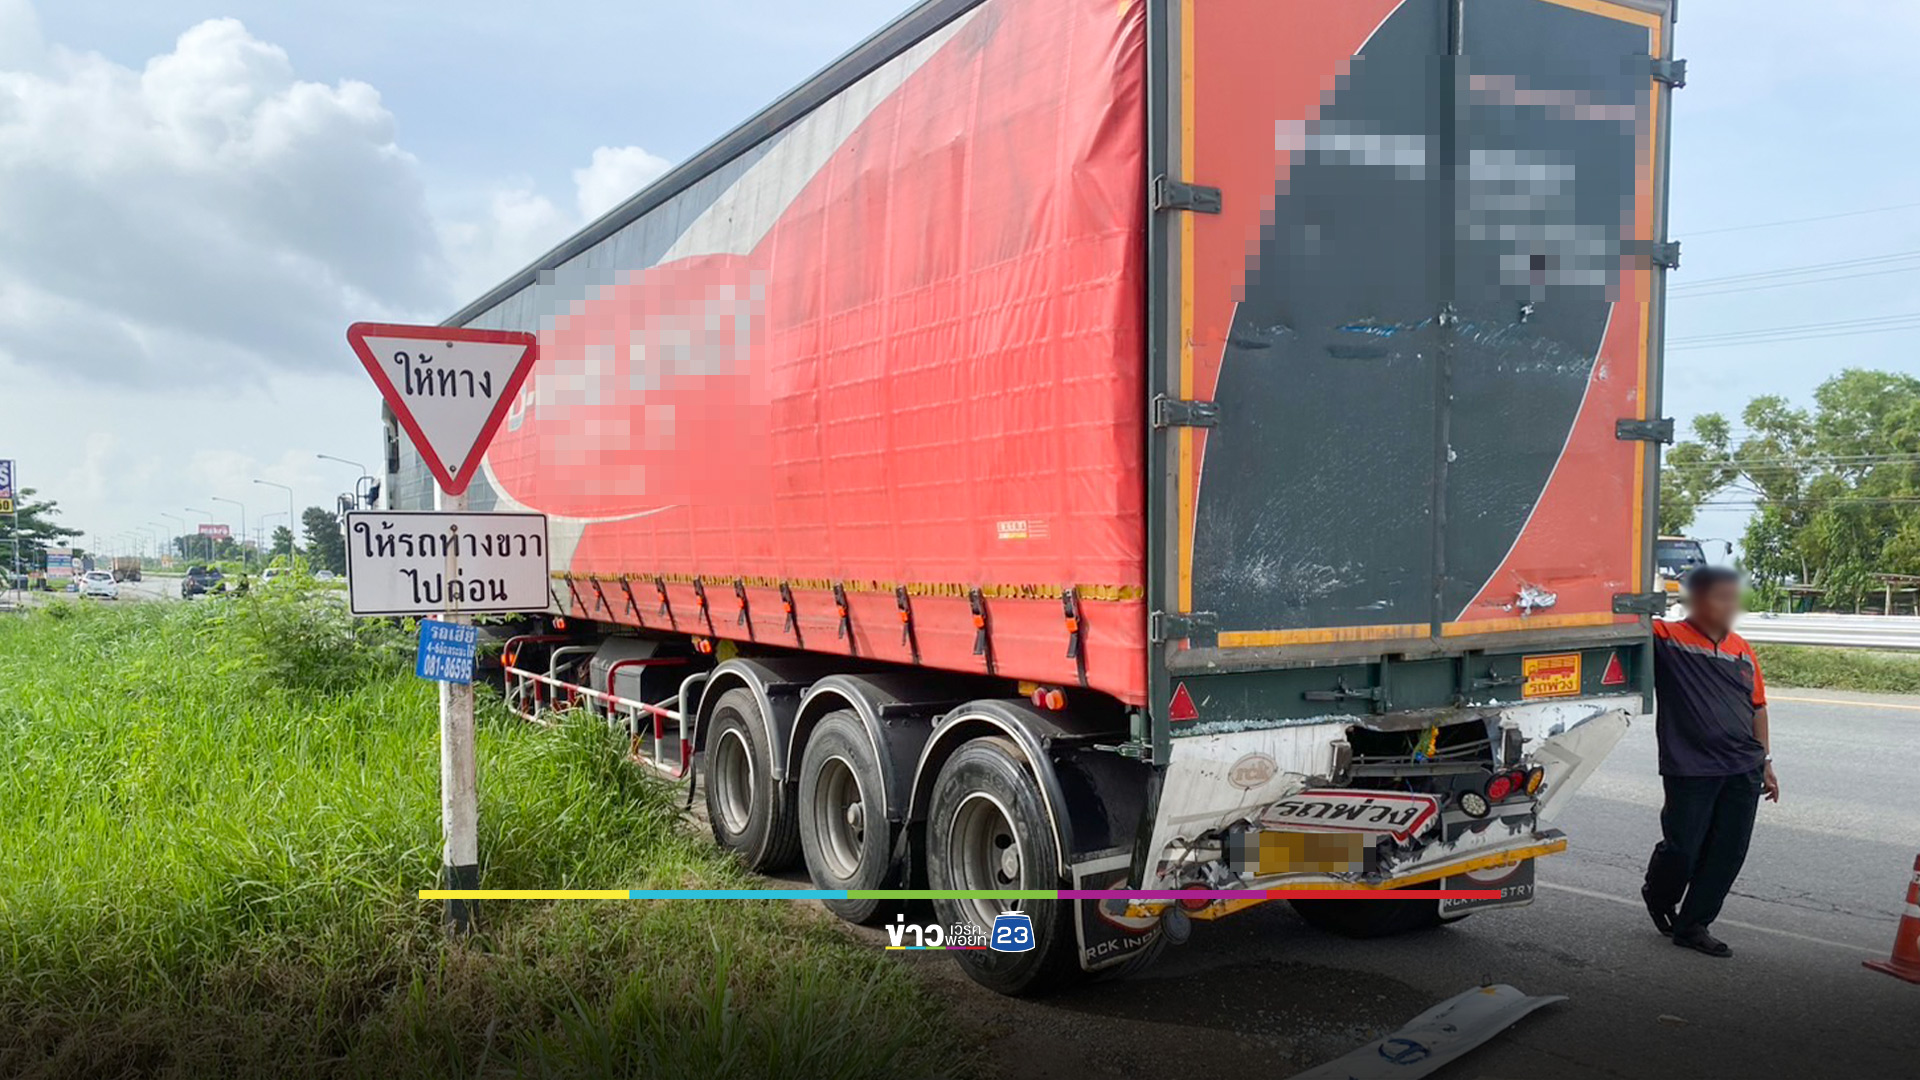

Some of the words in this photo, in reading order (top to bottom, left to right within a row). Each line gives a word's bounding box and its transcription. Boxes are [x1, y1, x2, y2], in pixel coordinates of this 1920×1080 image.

[394, 352, 492, 399] ให้ทาง
[354, 521, 542, 558] ให้รถทางขวา
[400, 568, 508, 604] ไปก่อน
[1529, 678, 1573, 692] รถพ่วง
[1275, 799, 1419, 826] รถพ่วง
[1086, 938, 1119, 961] RCK
